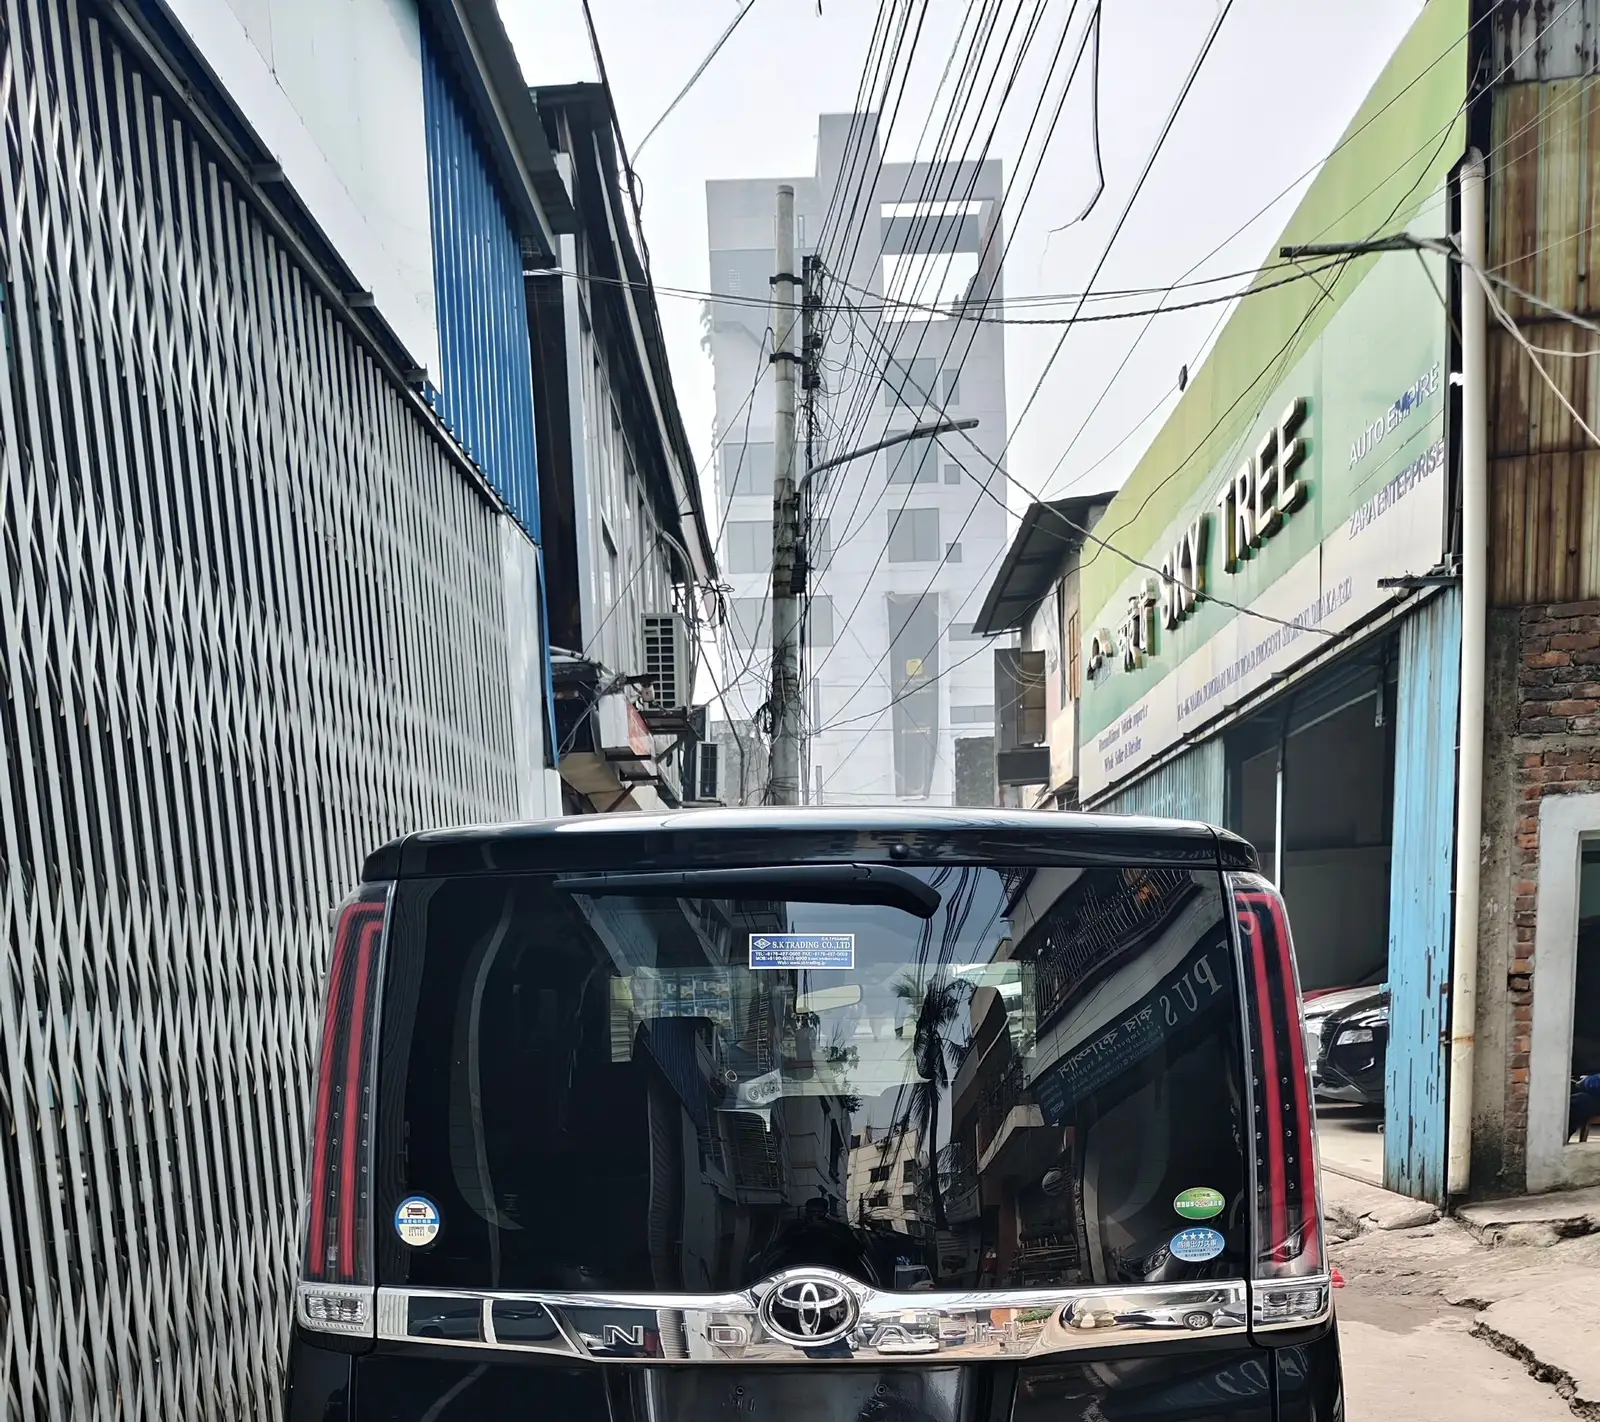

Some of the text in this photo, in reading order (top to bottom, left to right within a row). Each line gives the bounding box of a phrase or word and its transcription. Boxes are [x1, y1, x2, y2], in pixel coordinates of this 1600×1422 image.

[1349, 362, 1440, 470] AUTO EMPIRE
[1159, 397, 1307, 630] SKY TREE
[1349, 438, 1445, 540] ZARA ENTERPRISE
